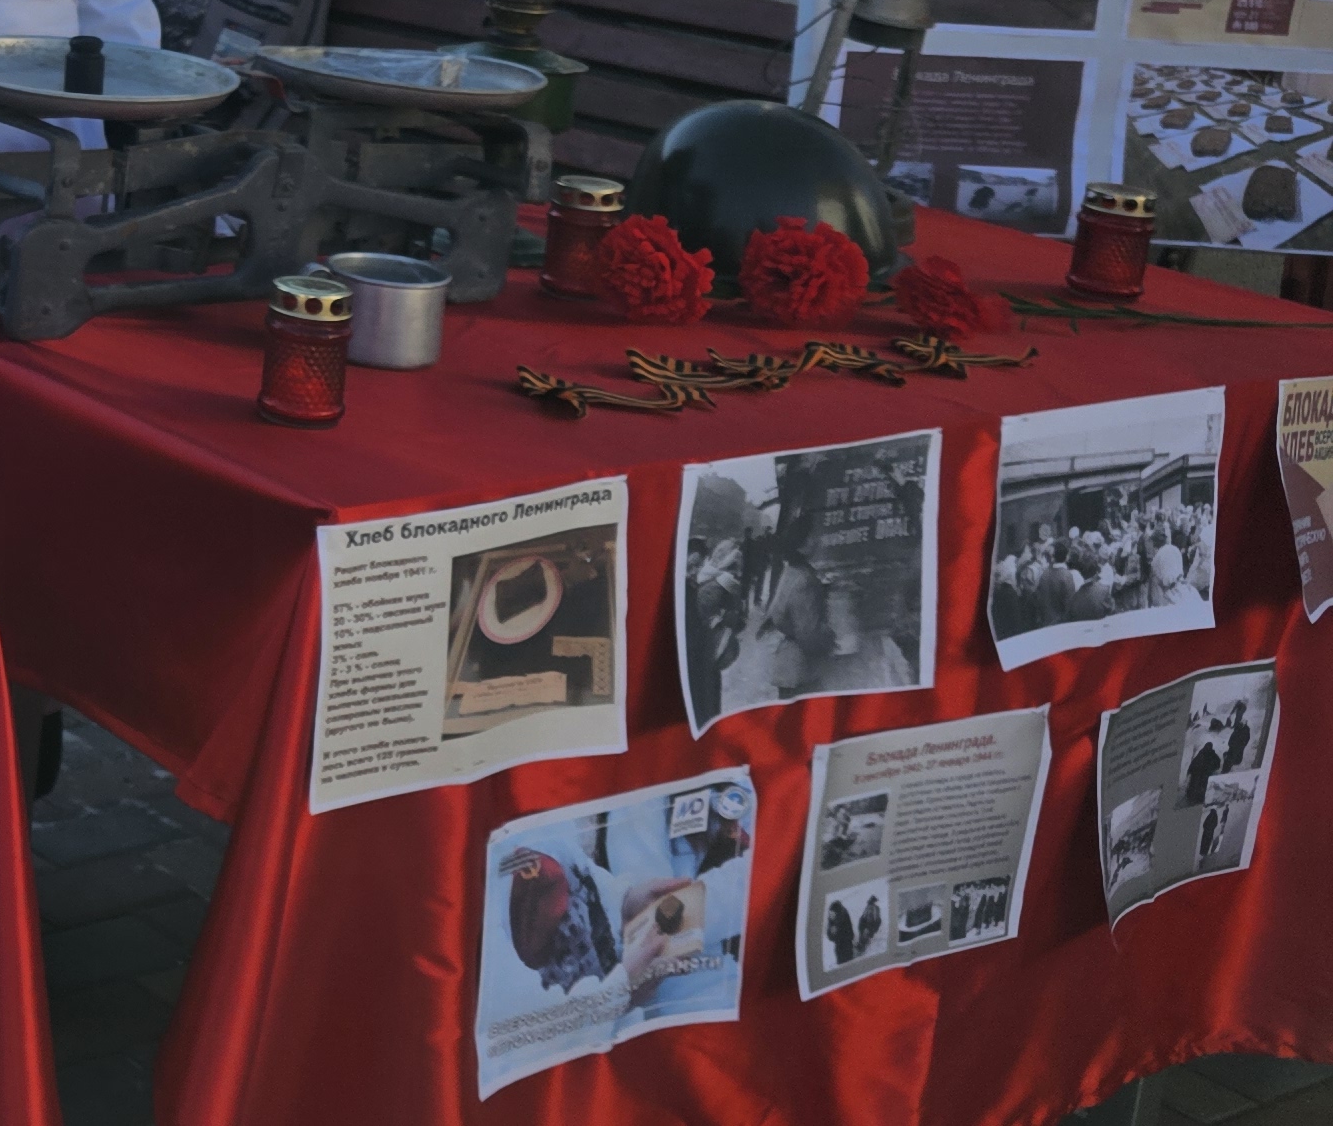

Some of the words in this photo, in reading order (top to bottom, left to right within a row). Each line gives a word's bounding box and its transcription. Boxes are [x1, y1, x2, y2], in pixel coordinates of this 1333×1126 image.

[345, 524, 394, 548] Хлеб
[401, 511, 509, 539] блокадного
[512, 488, 612, 522] Ленинграда
